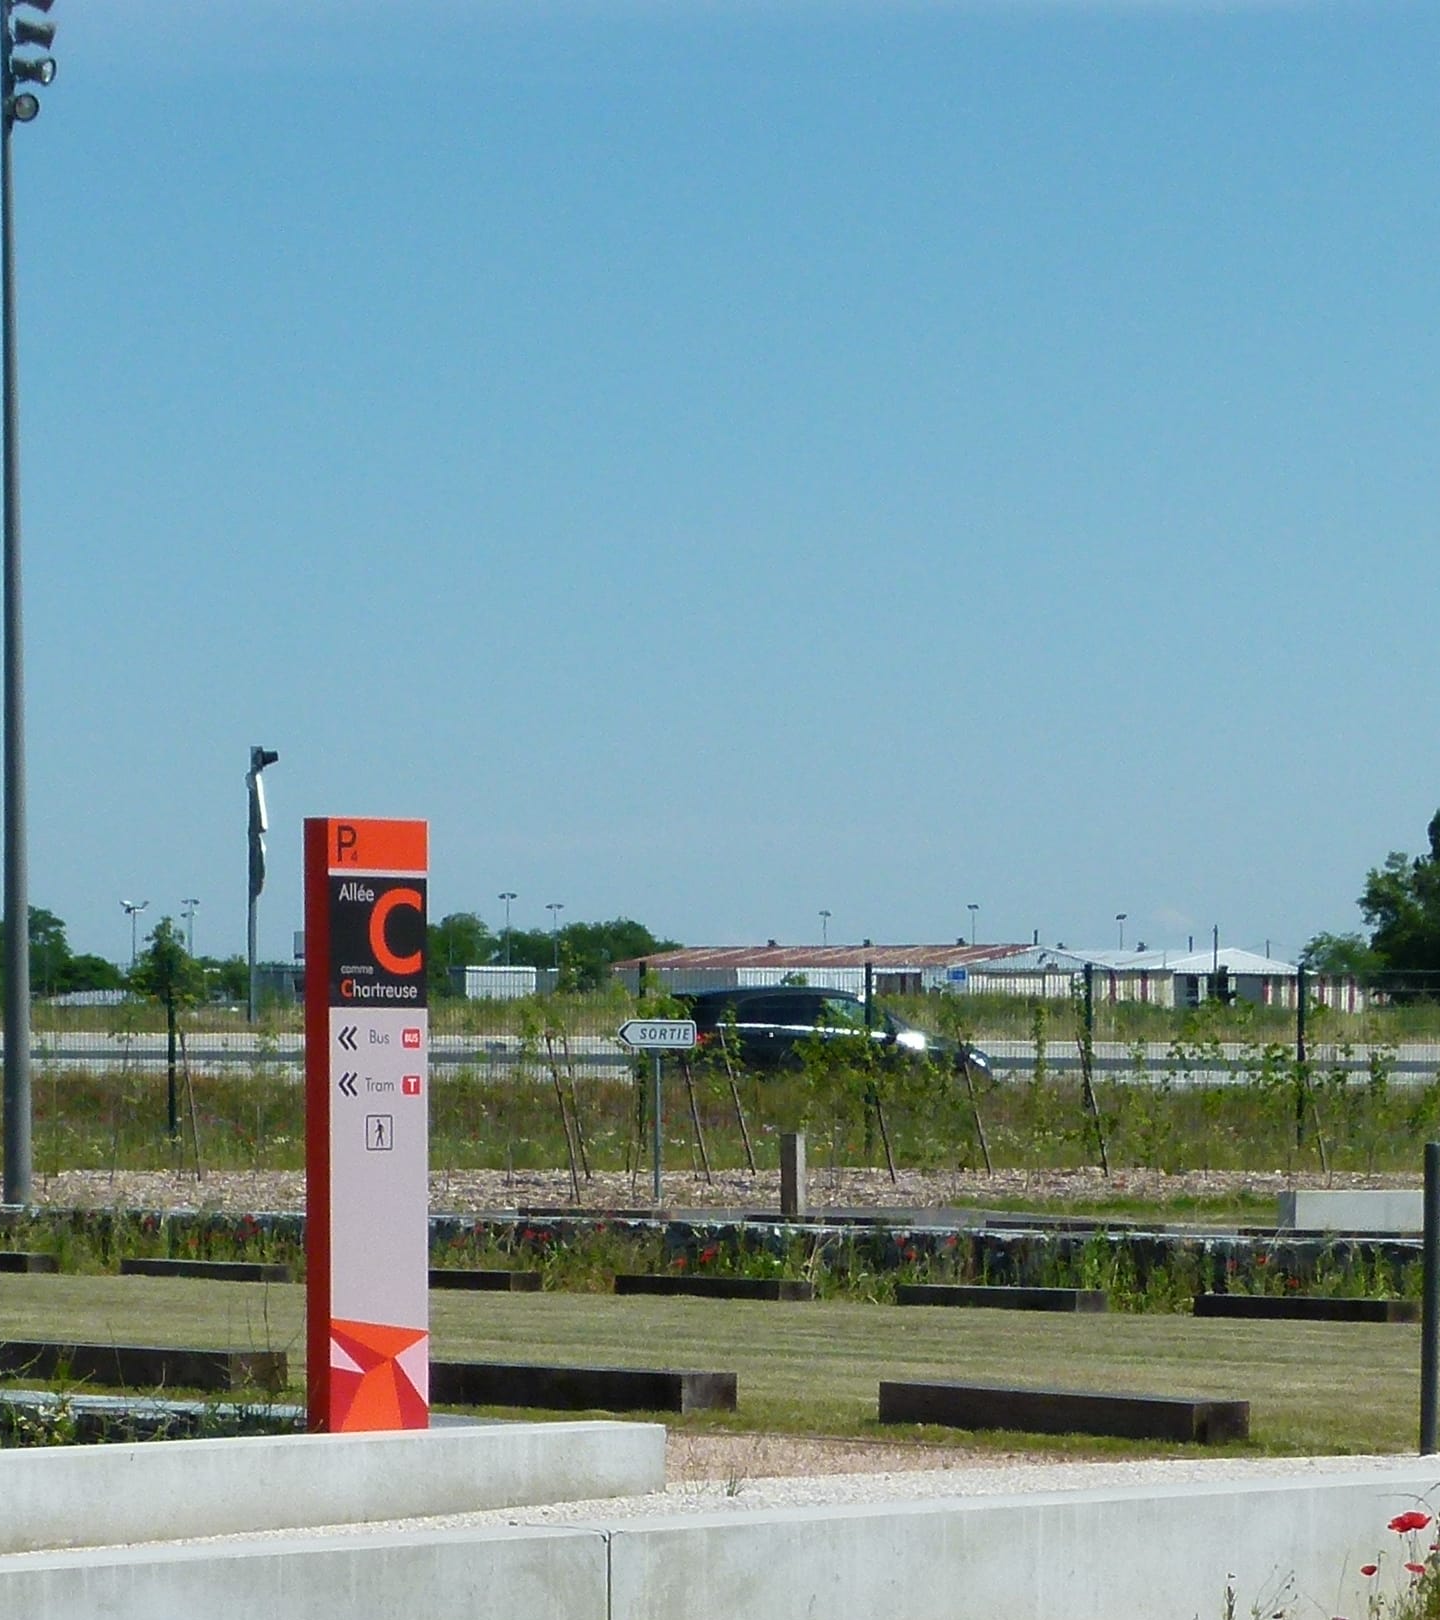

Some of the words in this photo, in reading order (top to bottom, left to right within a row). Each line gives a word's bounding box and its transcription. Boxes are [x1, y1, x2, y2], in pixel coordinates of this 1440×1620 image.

[339, 882, 375, 902] Allée
[370, 888, 422, 975] C
[340, 965, 374, 975] comme
[341, 978, 418, 998] Chartreuse
[369, 1029, 390, 1044] Bus
[639, 1028, 691, 1040] SORTIE
[365, 1077, 394, 1092] Tram
[407, 1078, 417, 1093] T
